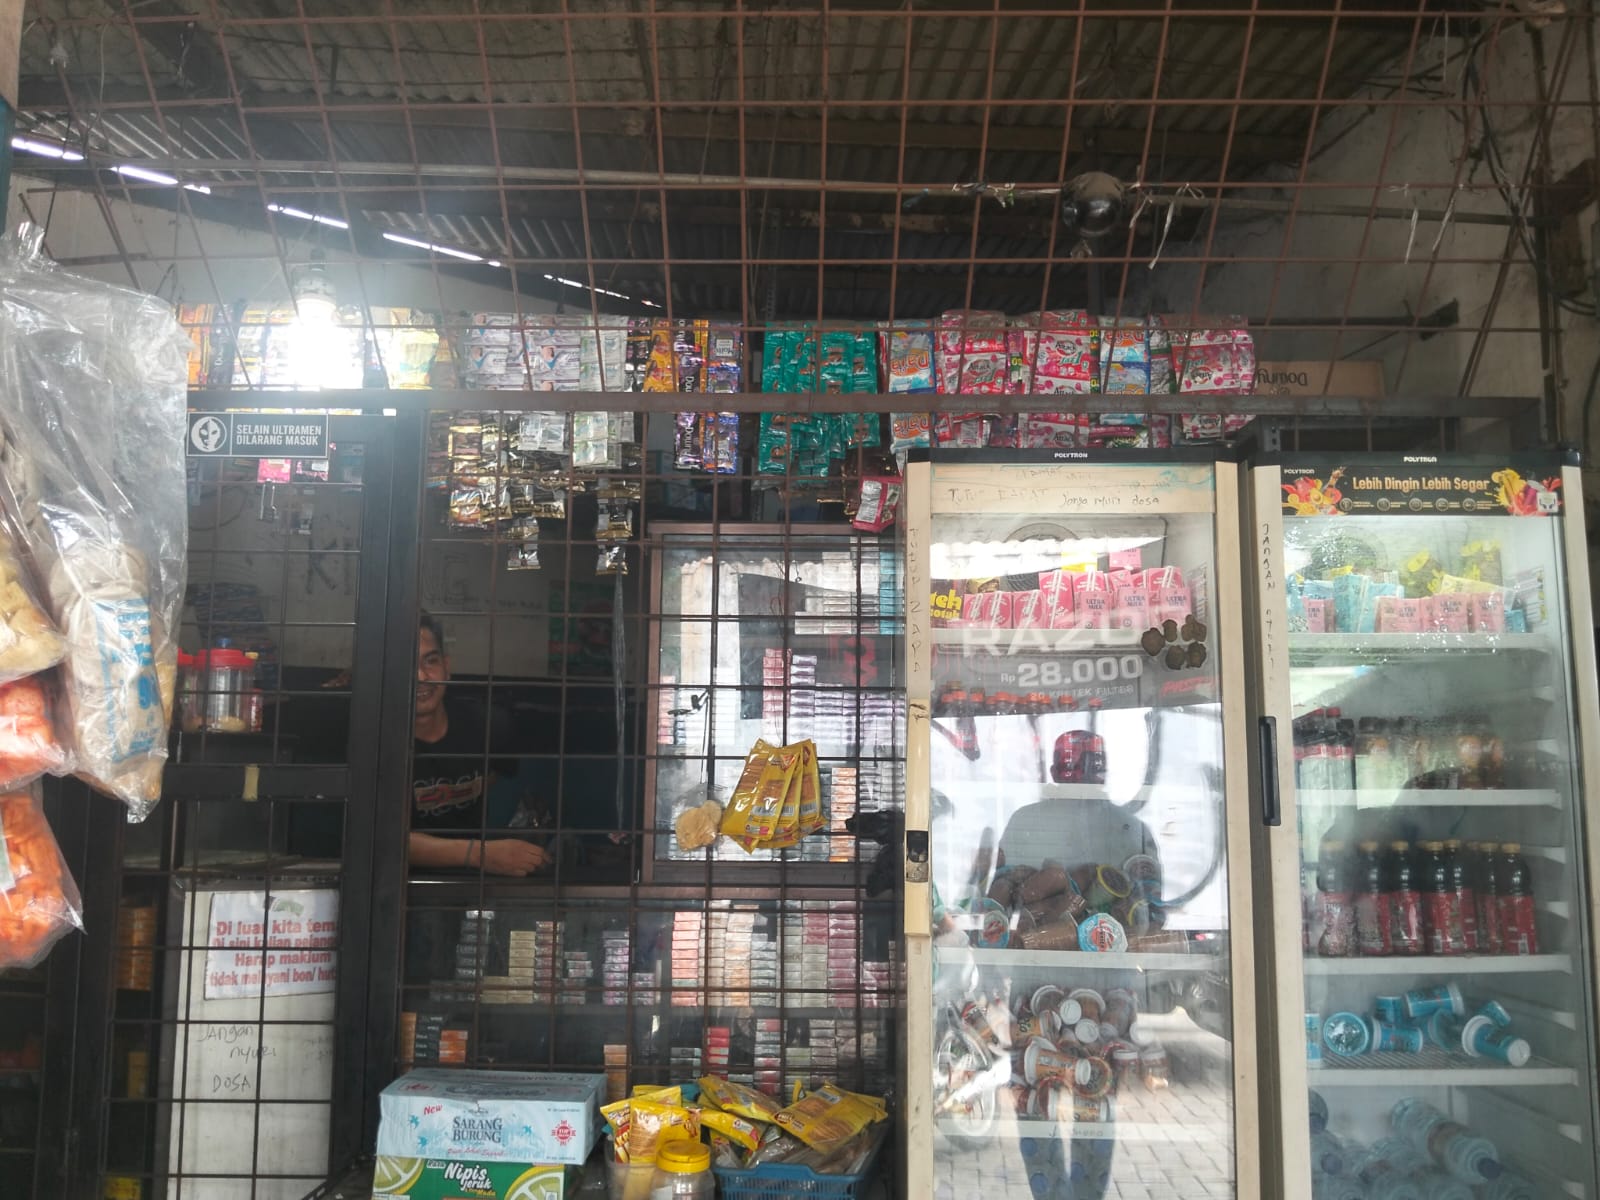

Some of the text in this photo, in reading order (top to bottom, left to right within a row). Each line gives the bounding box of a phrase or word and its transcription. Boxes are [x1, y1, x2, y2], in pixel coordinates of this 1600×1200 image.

[1257, 368, 1308, 387] Downy
[236, 424, 322, 436] SELAIN ULTRAMEN
[236, 435, 319, 446] DILARANG MASUK
[1353, 476, 1491, 493] Lebih Dingin Lebih Segar
[1001, 672, 1016, 685] Rp
[1018, 654, 1143, 688] 28.000
[215, 921, 233, 936] Di
[271, 919, 302, 934] kita
[306, 919, 337, 933] tem
[235, 951, 332, 968] Harp maklum
[210, 971, 239, 986] tidak
[213, 1073, 251, 1093] DOSA
[423, 1104, 443, 1115] New
[452, 1116, 503, 1131] SARANG
[452, 1129, 502, 1144] BURUNG
[444, 1162, 488, 1184] Nipis
